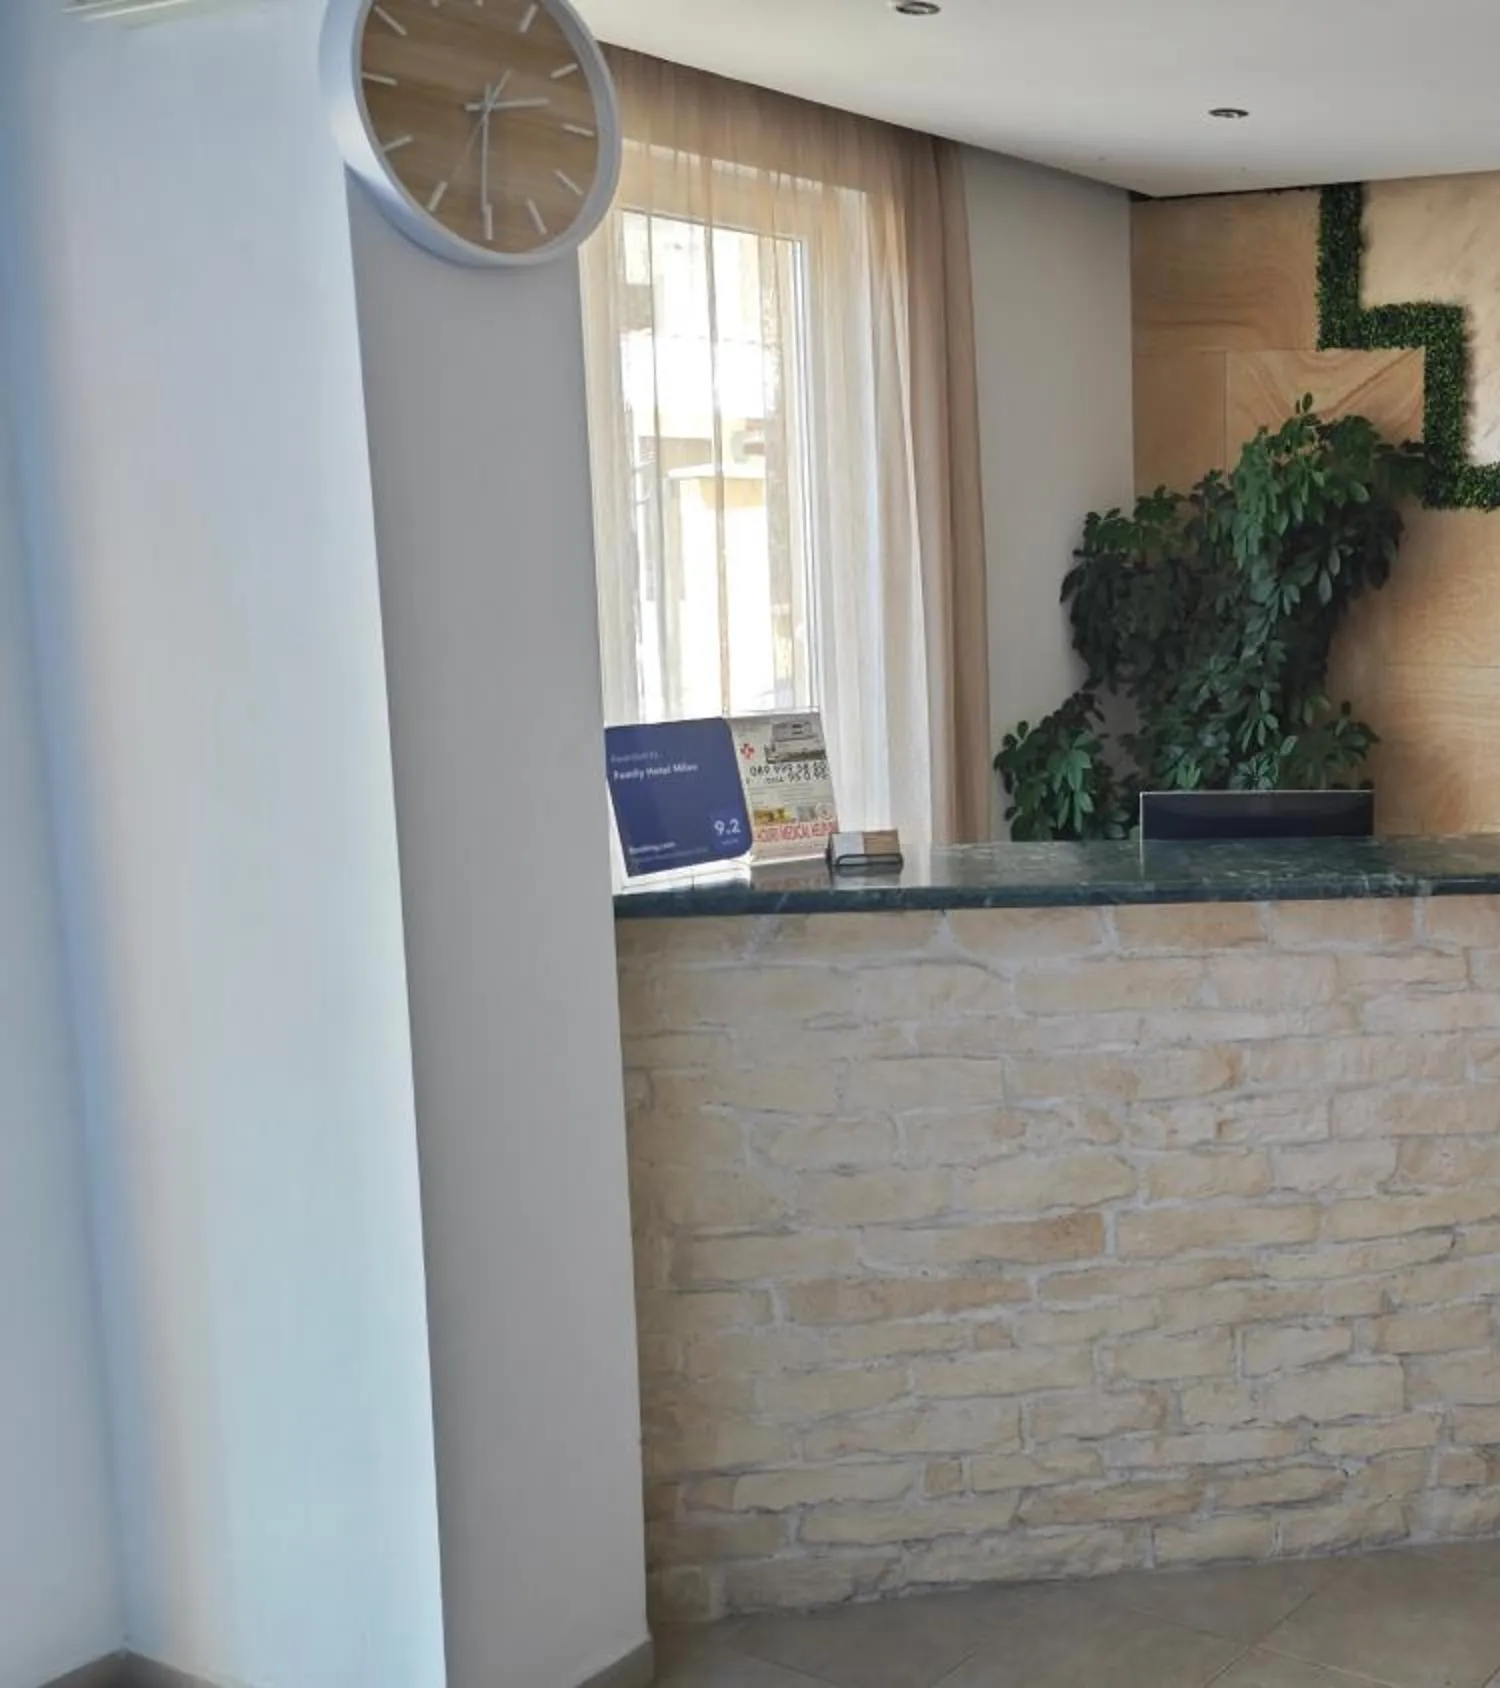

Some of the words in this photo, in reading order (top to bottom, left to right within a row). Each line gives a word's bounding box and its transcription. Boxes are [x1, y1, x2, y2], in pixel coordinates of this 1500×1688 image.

[613, 766, 645, 782] Family
[645, 764, 672, 777] Hotel
[713, 817, 741, 837] 9.2
